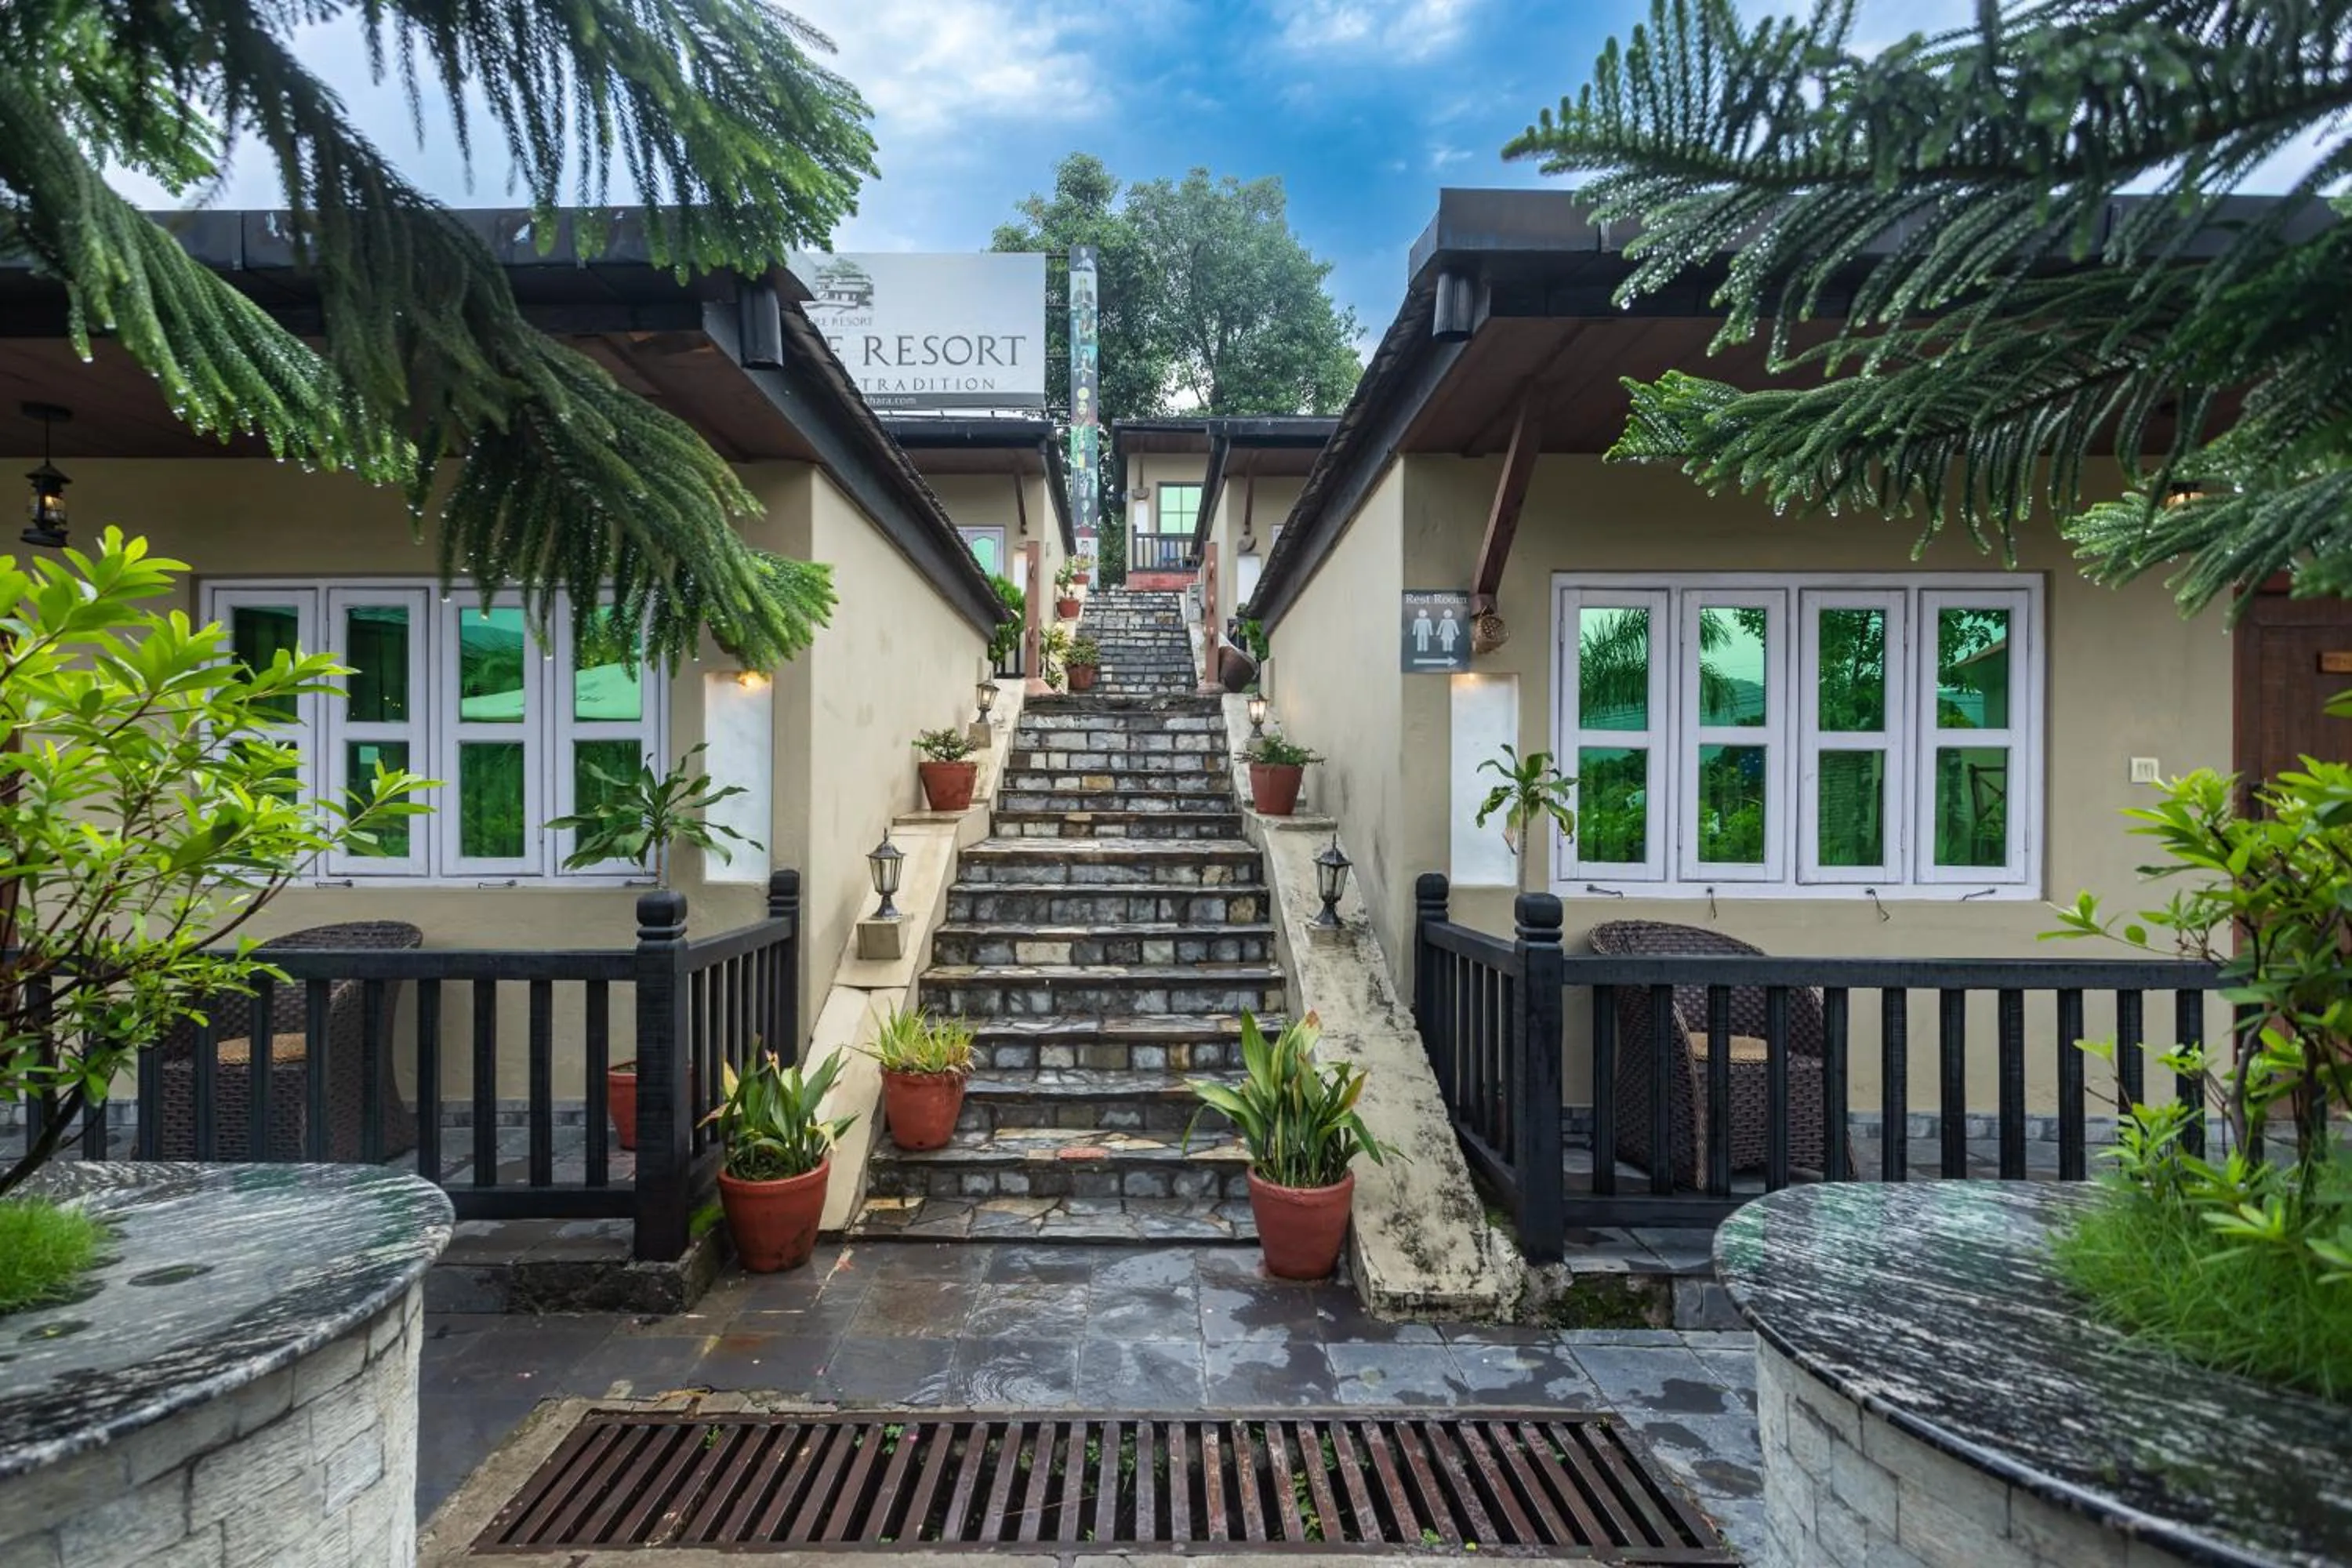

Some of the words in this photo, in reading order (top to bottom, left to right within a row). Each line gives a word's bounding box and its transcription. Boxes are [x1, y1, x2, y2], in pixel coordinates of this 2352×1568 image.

[863, 335, 1026, 366] RESORT
[861, 378, 995, 390] TRADITION
[1405, 593, 1429, 604] Rest
[1434, 593, 1468, 604] Room
